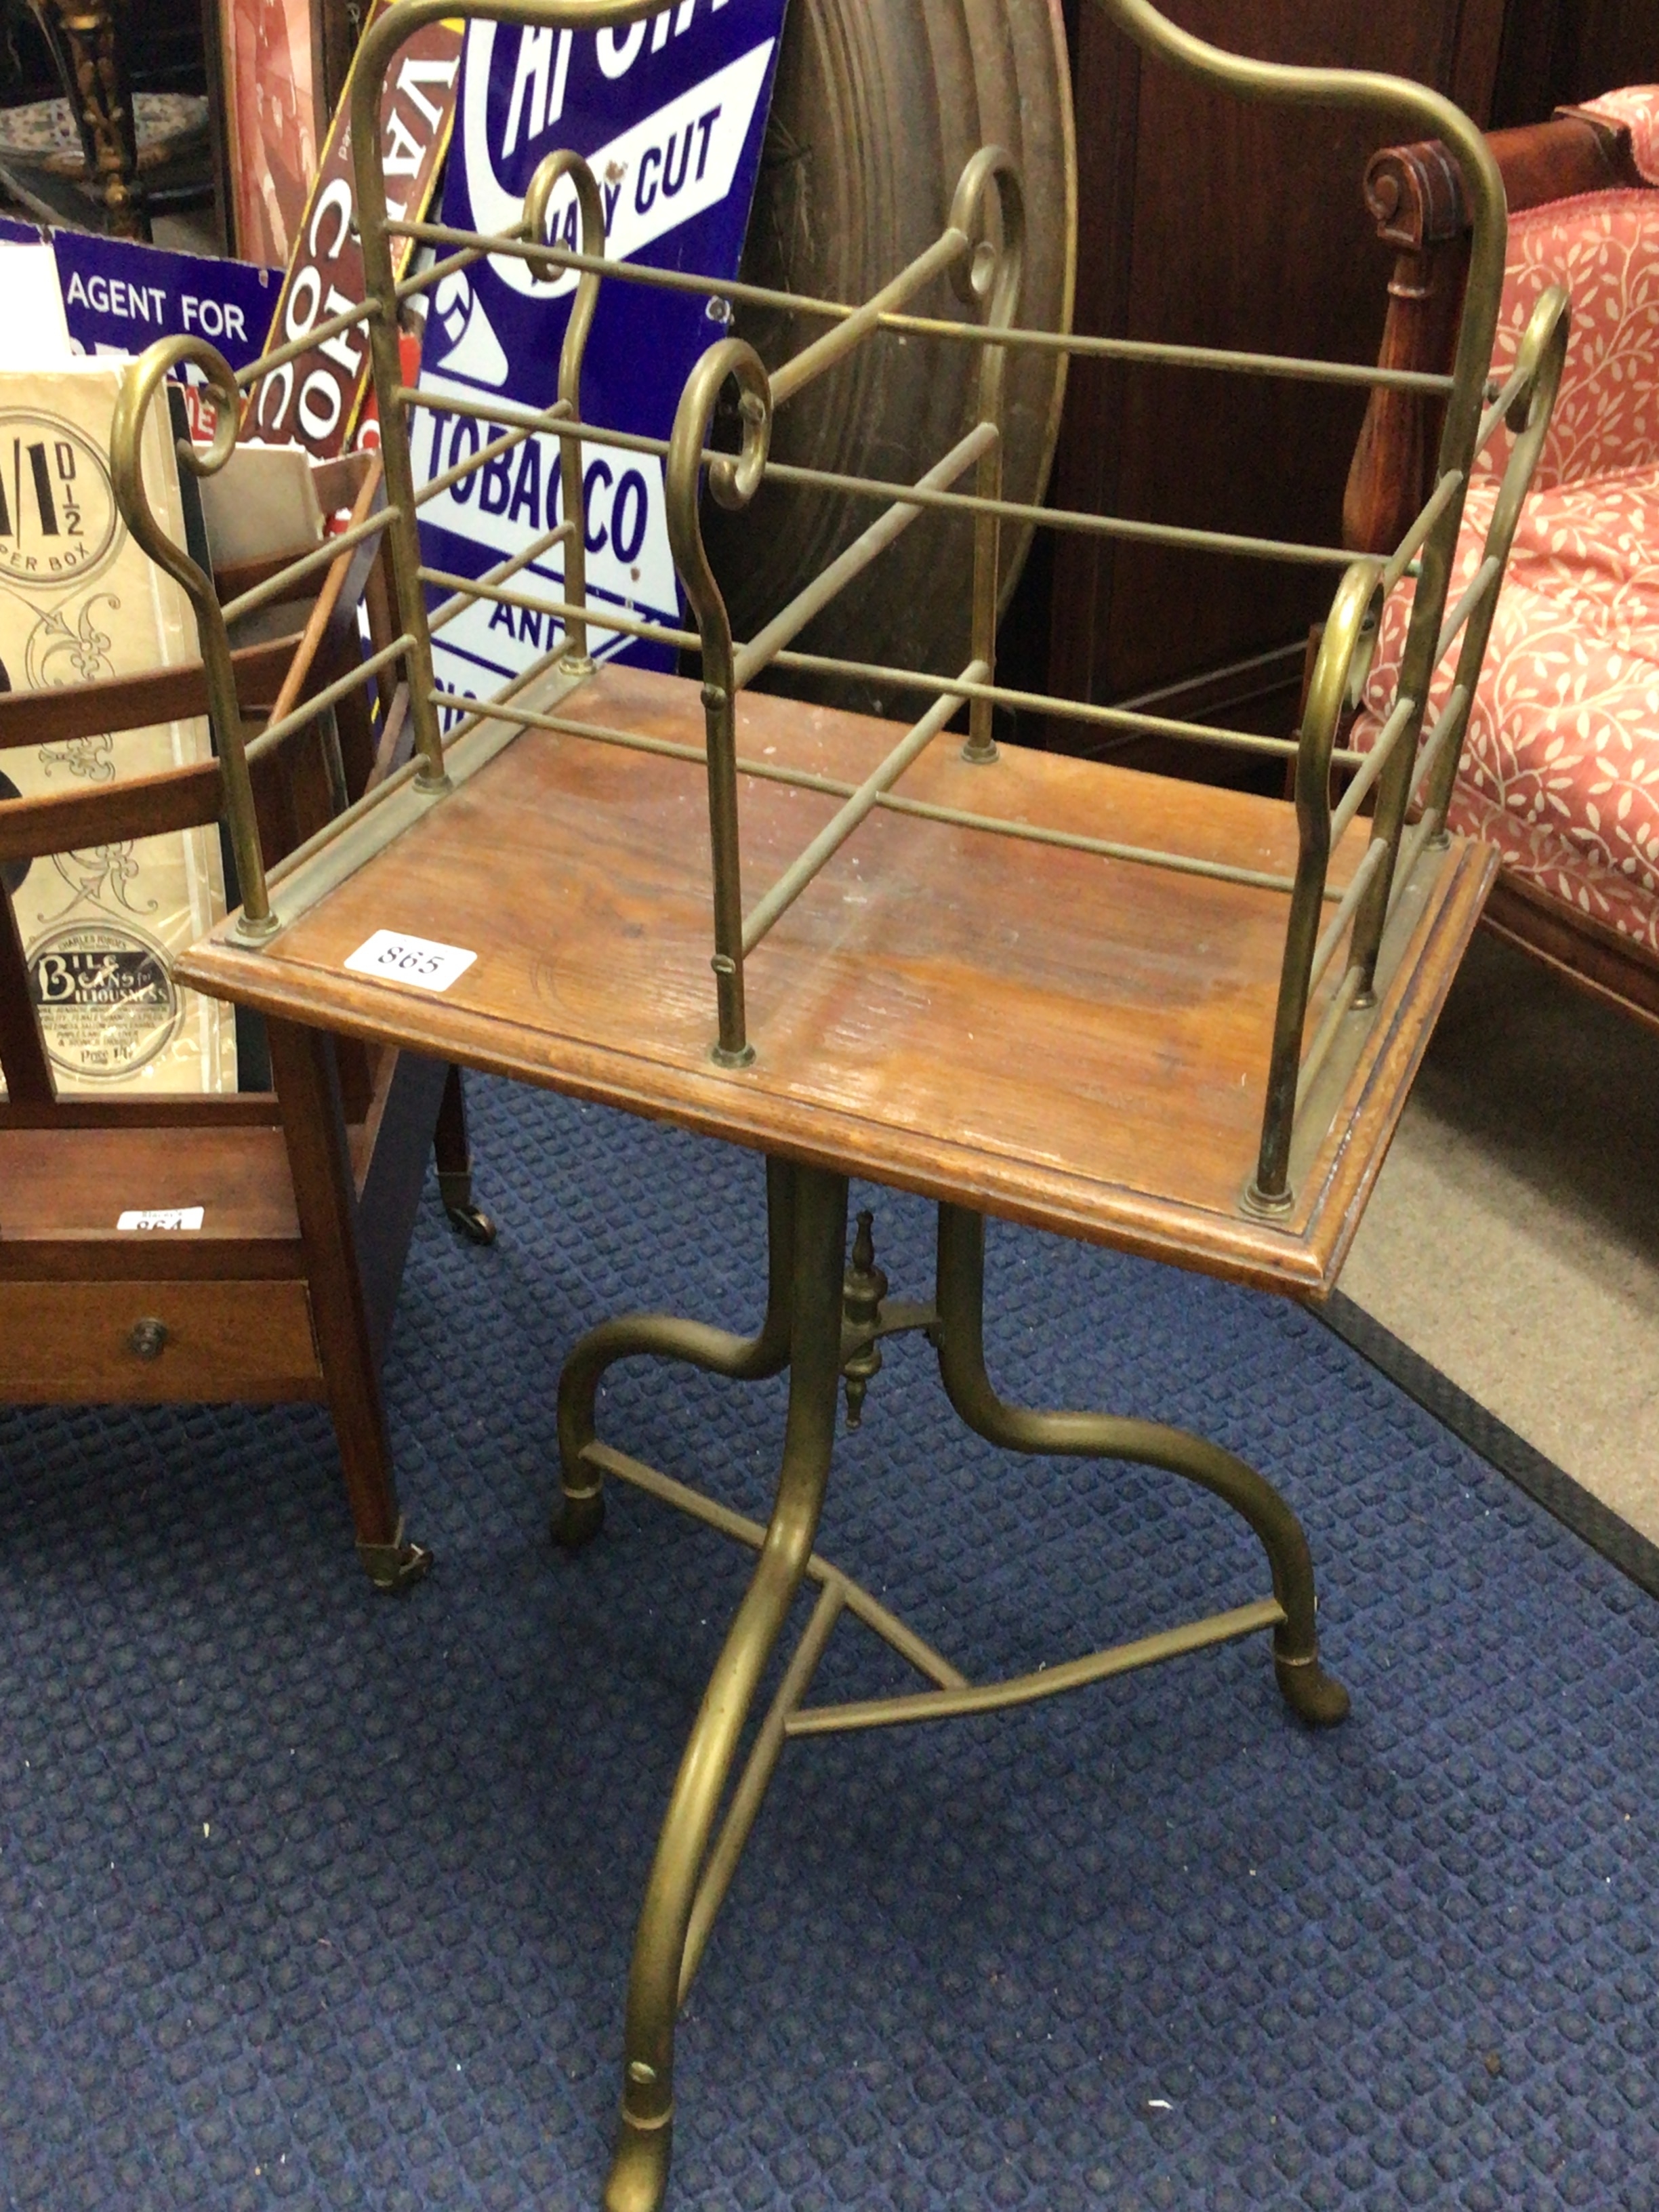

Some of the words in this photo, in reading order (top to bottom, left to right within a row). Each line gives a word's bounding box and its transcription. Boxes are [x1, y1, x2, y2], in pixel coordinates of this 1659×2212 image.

[634, 103, 722, 216] CUT
[67, 271, 167, 325] AGENT
[182, 294, 248, 342] FOR
[247, 178, 352, 446] COC
[49, 541, 90, 571] BOX
[377, 946, 445, 974] 865
